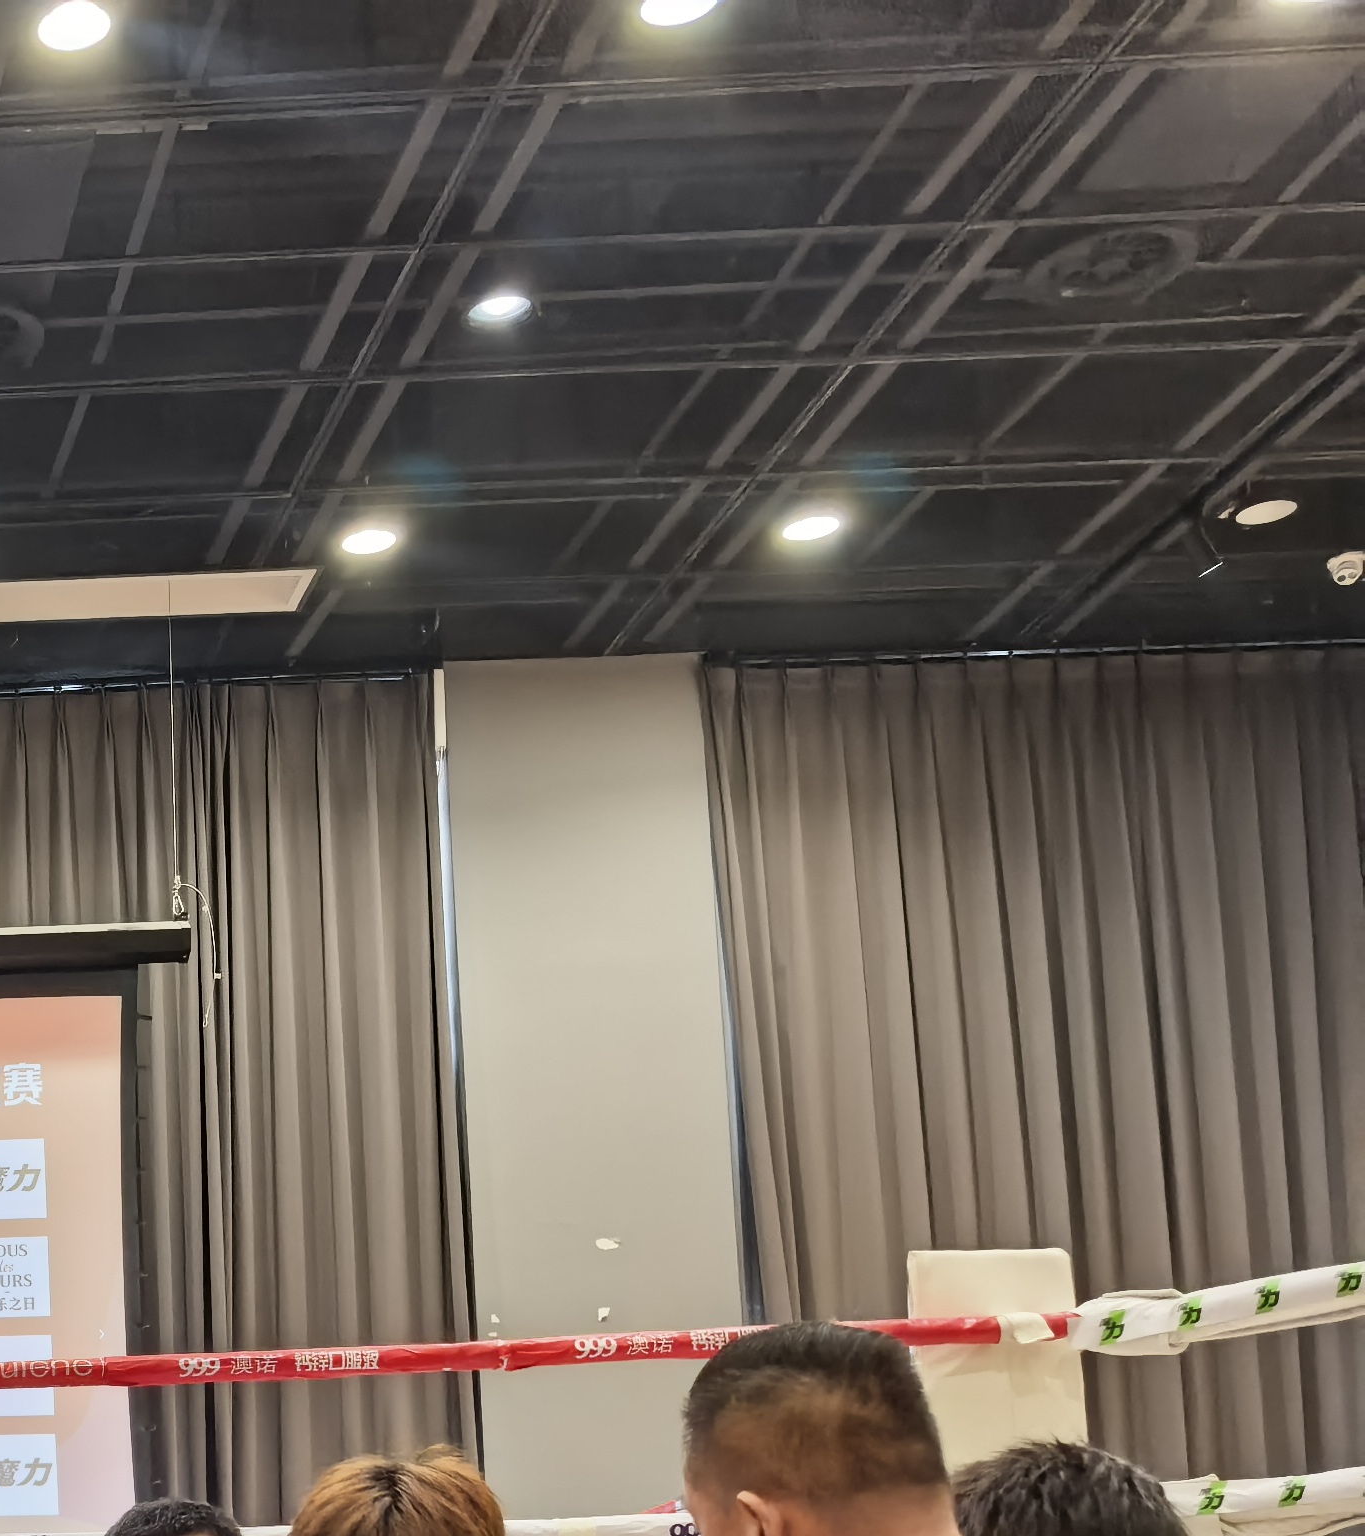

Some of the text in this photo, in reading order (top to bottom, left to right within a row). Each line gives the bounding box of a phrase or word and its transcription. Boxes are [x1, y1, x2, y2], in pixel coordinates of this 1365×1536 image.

[574, 1334, 674, 1359] 999 澳诺
[179, 1350, 379, 1378] 999 澳诺 钙锌口服液
